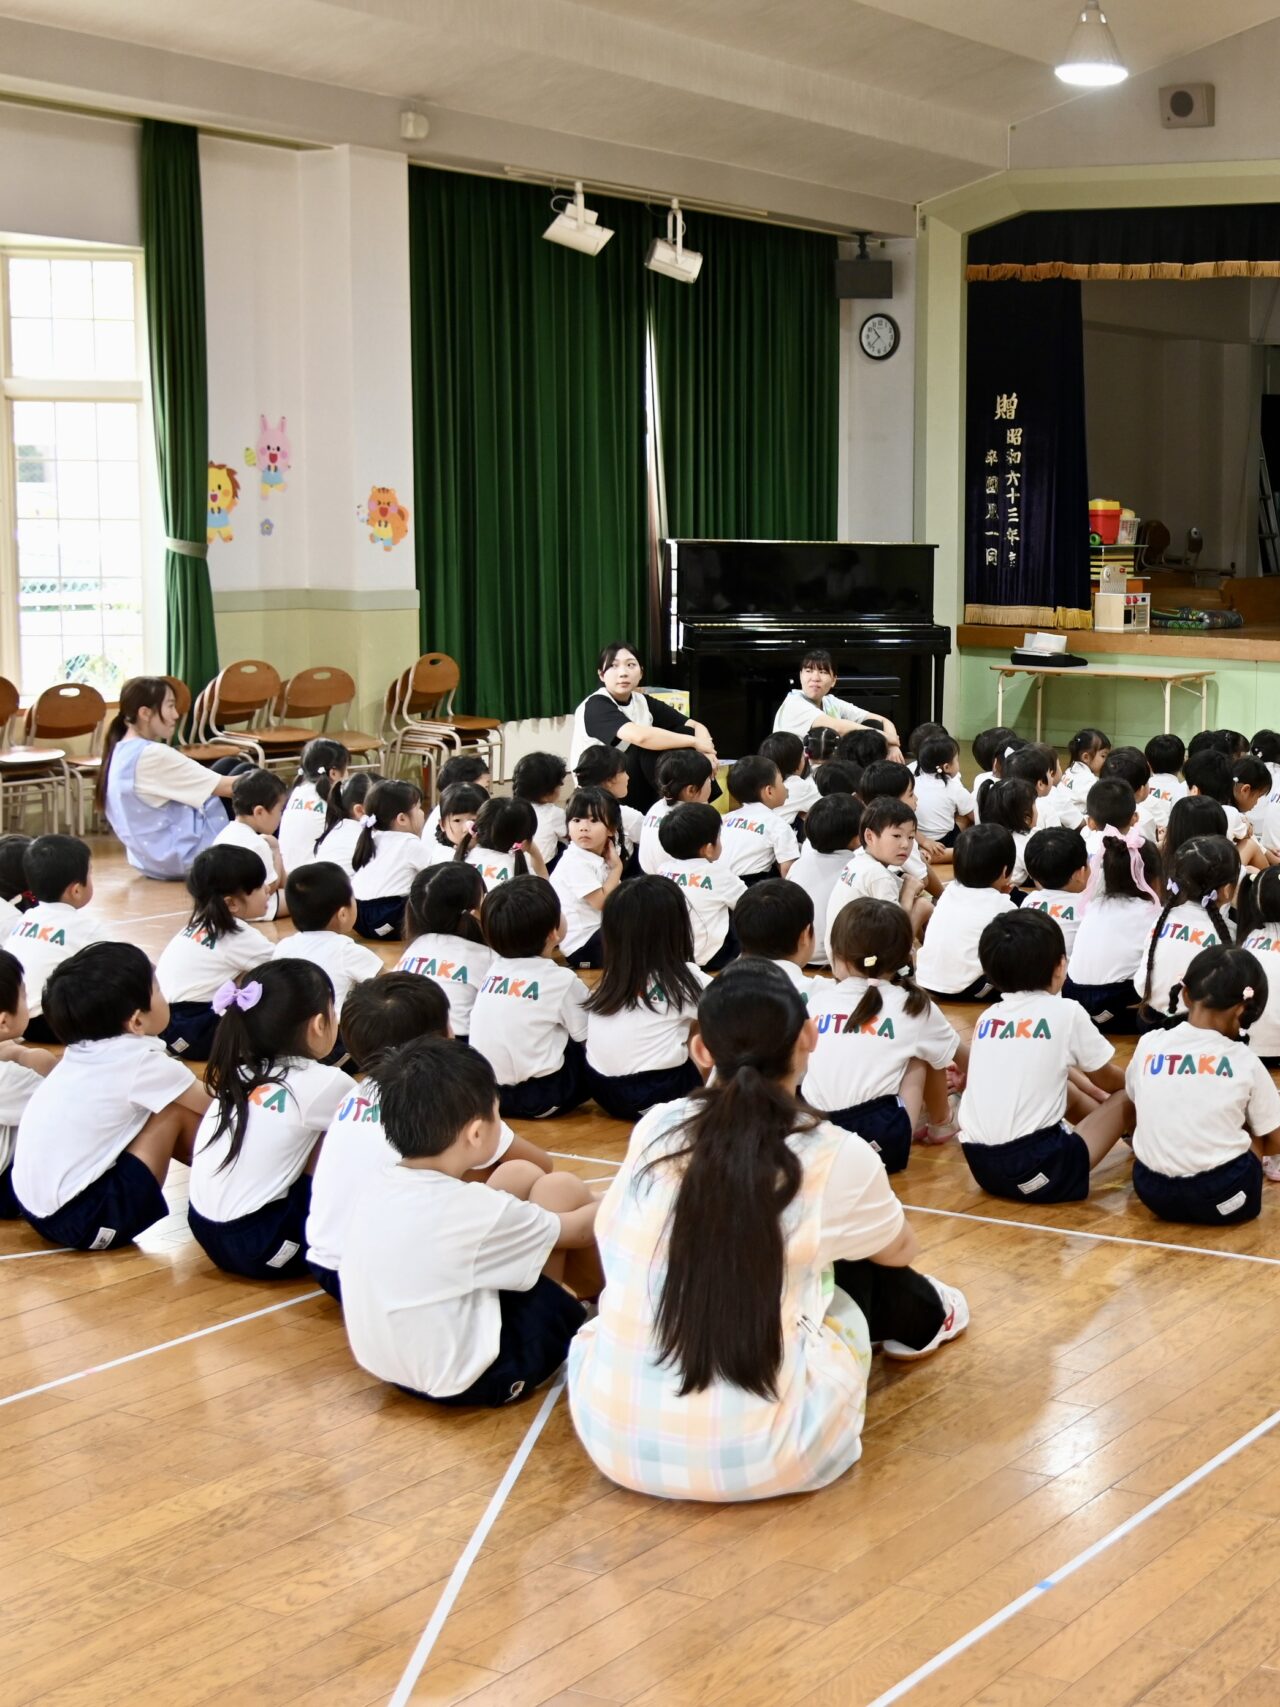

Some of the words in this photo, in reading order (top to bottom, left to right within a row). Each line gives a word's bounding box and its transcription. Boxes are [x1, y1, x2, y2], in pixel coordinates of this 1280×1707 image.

[994, 392, 1018, 420] 贈
[725, 817, 765, 835] UTAKA
[398, 957, 468, 984] UTAKA
[481, 975, 539, 1000] UTAKA
[976, 1017, 1052, 1039] UTAKA
